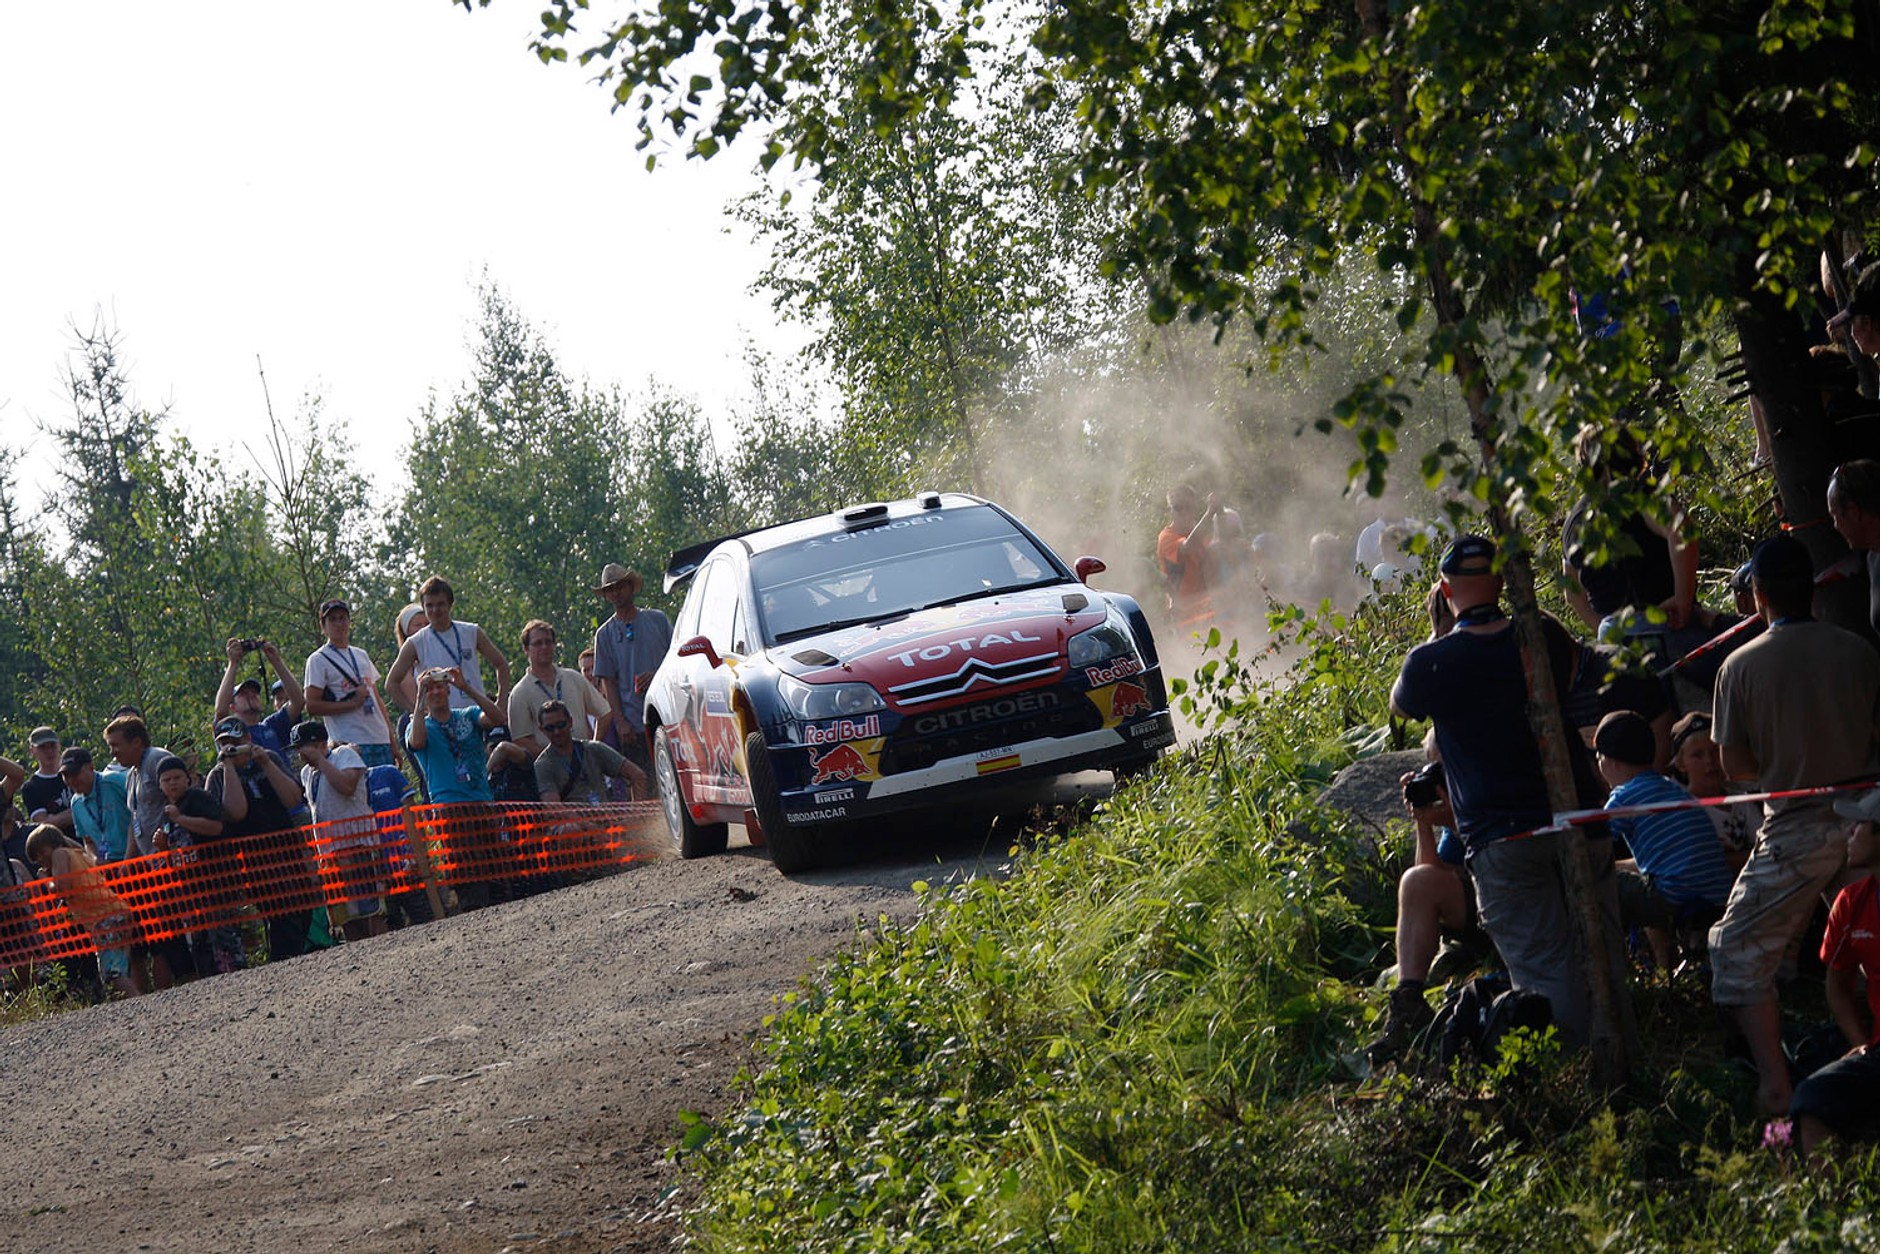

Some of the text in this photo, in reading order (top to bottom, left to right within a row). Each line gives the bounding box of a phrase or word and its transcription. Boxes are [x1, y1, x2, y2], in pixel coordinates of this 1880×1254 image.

[887, 630, 1041, 668] TOTAL
[1084, 657, 1121, 687] Red
[805, 714, 880, 745] Red Bull
[814, 787, 855, 804] PIRELLI
[786, 806, 847, 823] EURODATACAR
